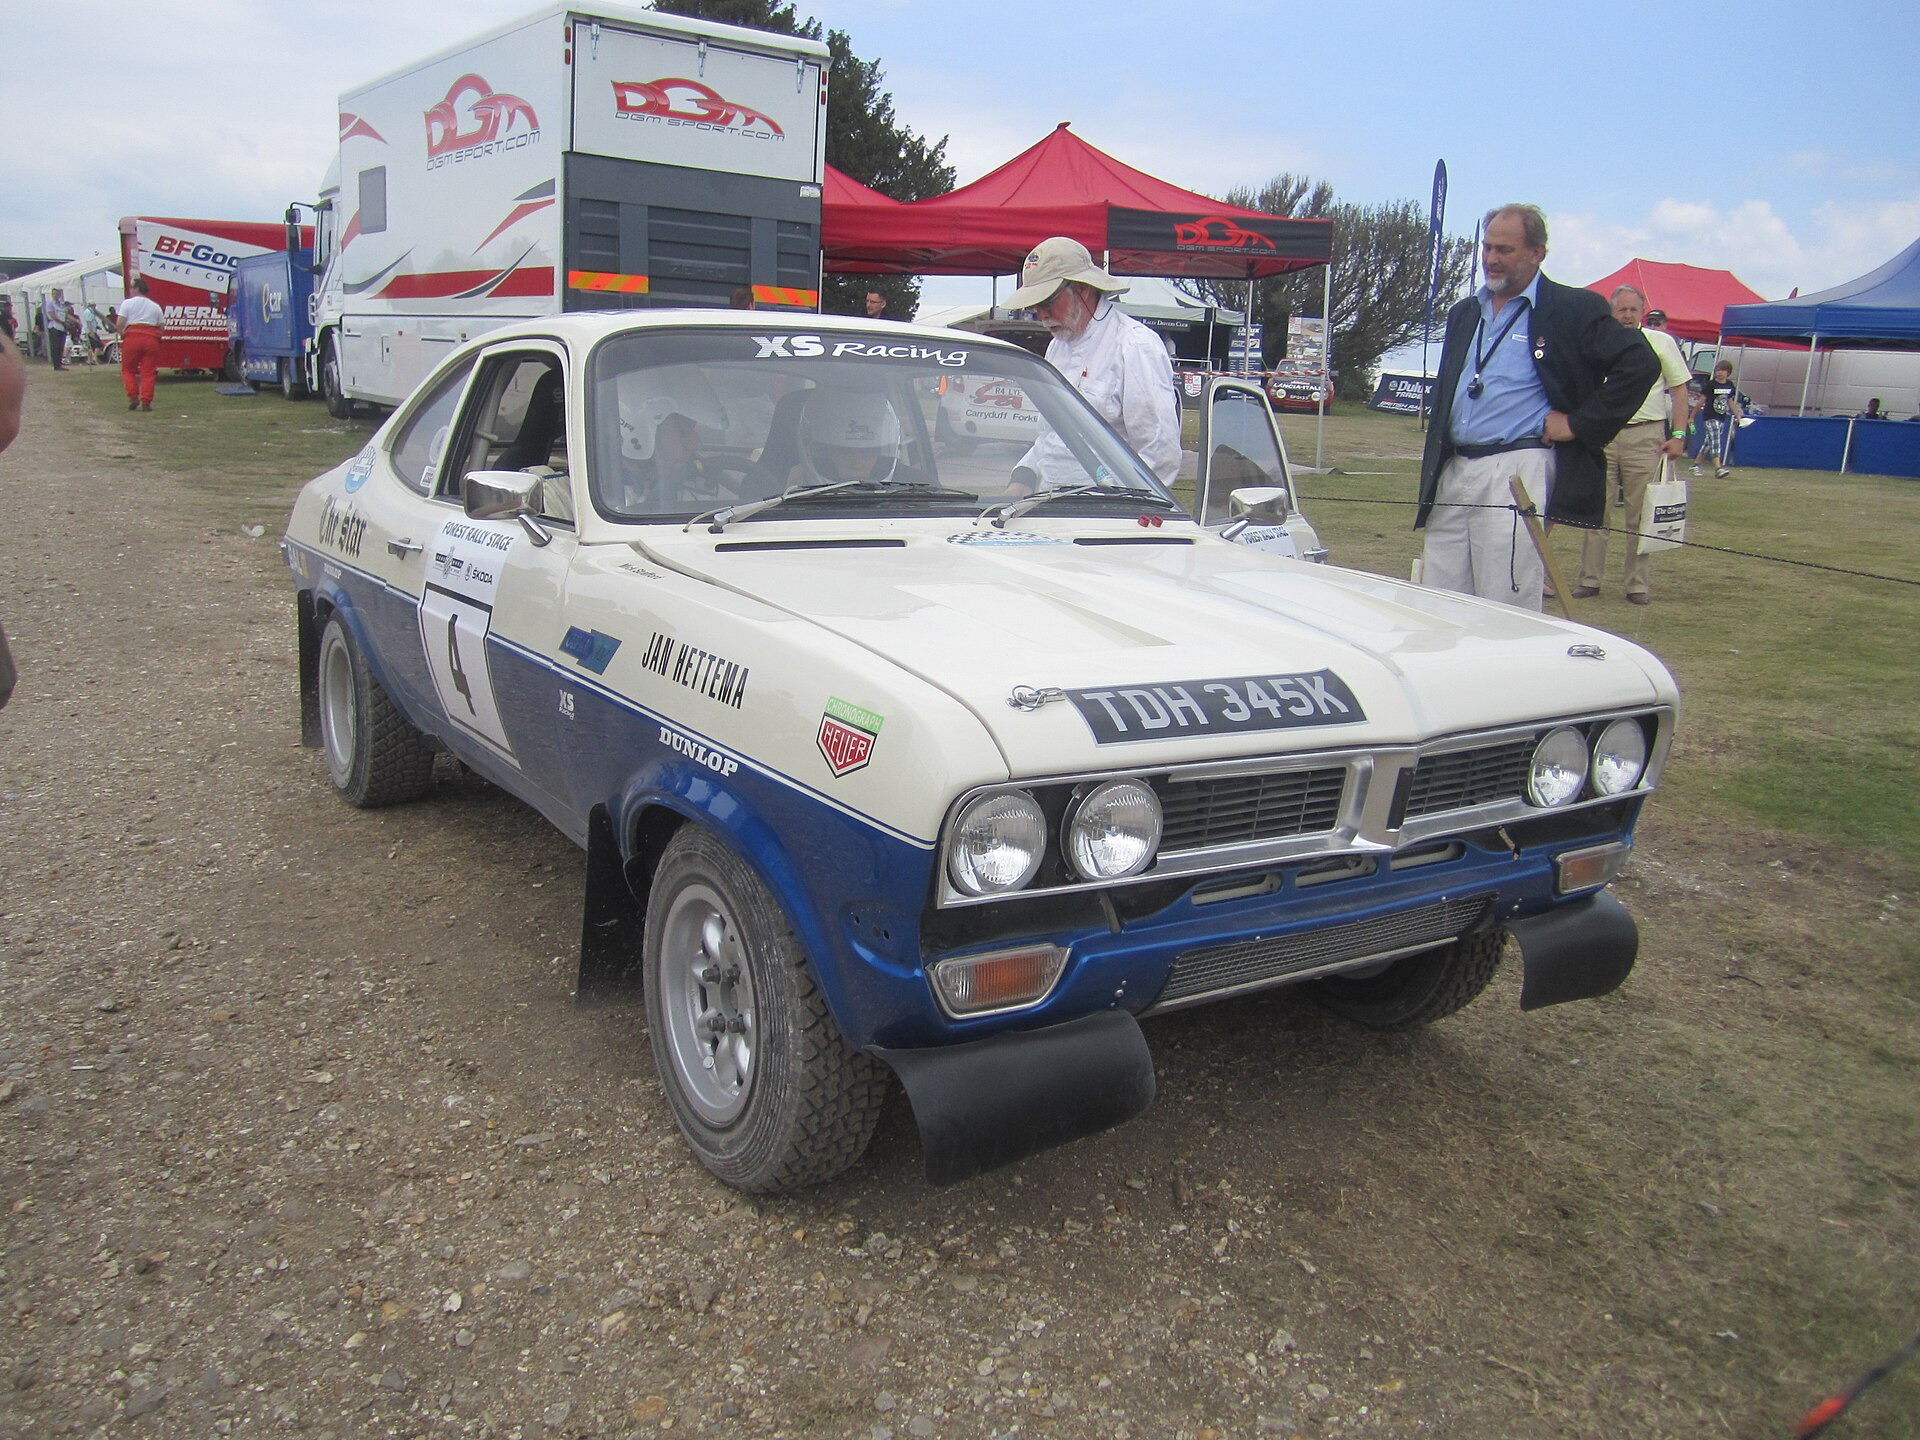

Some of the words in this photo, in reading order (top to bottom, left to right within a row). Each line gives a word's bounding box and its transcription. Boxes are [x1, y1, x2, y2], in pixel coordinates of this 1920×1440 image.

[615, 111, 662, 124] DGM
[667, 118, 785, 142] SPORT.COM
[426, 152, 454, 171] DGM
[454, 130, 541, 163] SPORT.COM
[149, 260, 191, 275] TAKE
[750, 336, 825, 358] XS
[831, 342, 970, 367] Racing
[965, 409, 1008, 420] Carryduff
[442, 521, 470, 539] FOREST
[465, 527, 491, 545] RALLY
[486, 532, 515, 552] STAGE
[447, 613, 477, 717] 4
[641, 631, 675, 677] JAN
[672, 643, 750, 710] HETTEMA
[558, 689, 574, 712] XS
[826, 698, 882, 731] CHRONOGRAPH
[1080, 686, 1210, 733] TDH
[1203, 675, 1350, 723] 345K
[658, 726, 739, 777] DUNLOP
[823, 724, 868, 766] HEUER
